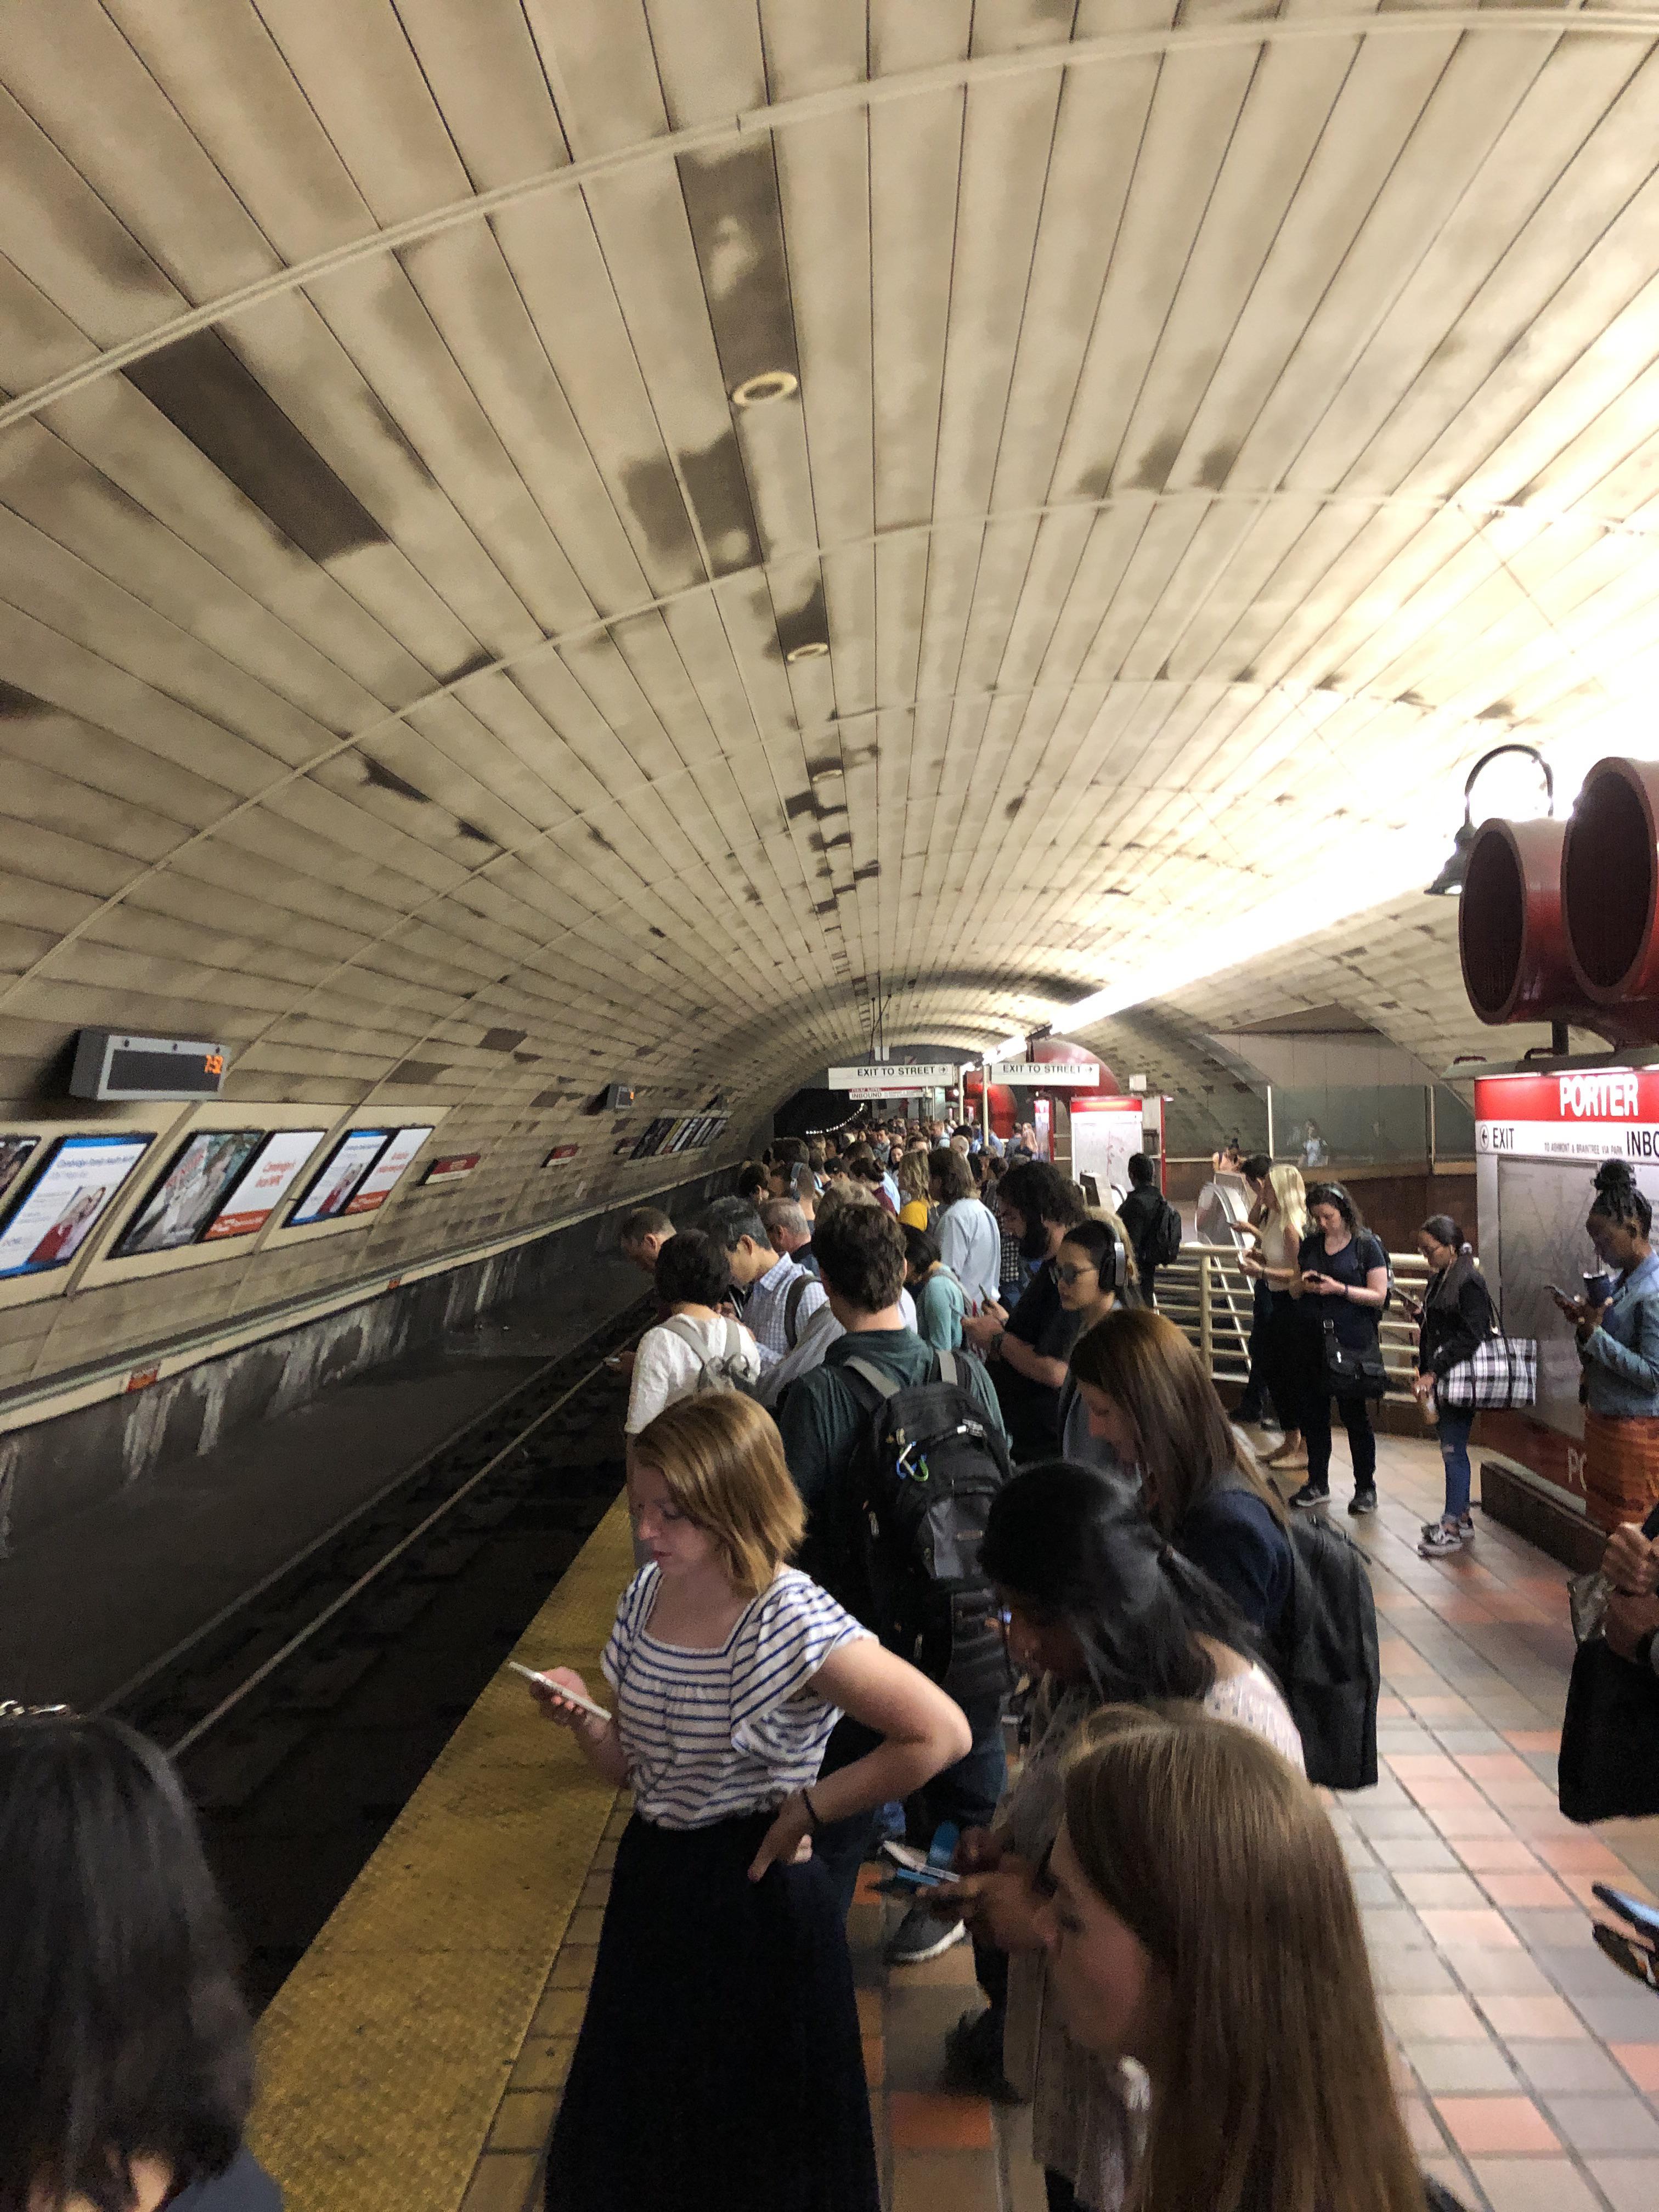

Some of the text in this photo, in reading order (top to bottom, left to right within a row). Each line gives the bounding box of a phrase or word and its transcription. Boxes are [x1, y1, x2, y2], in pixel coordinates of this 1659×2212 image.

[857, 1066, 935, 1077] EXIT TO STREET
[1003, 1064, 1081, 1074] EXIT TO STREET
[1559, 1074, 1639, 1117] PORTER
[1493, 1127, 1515, 1150] EXIT
